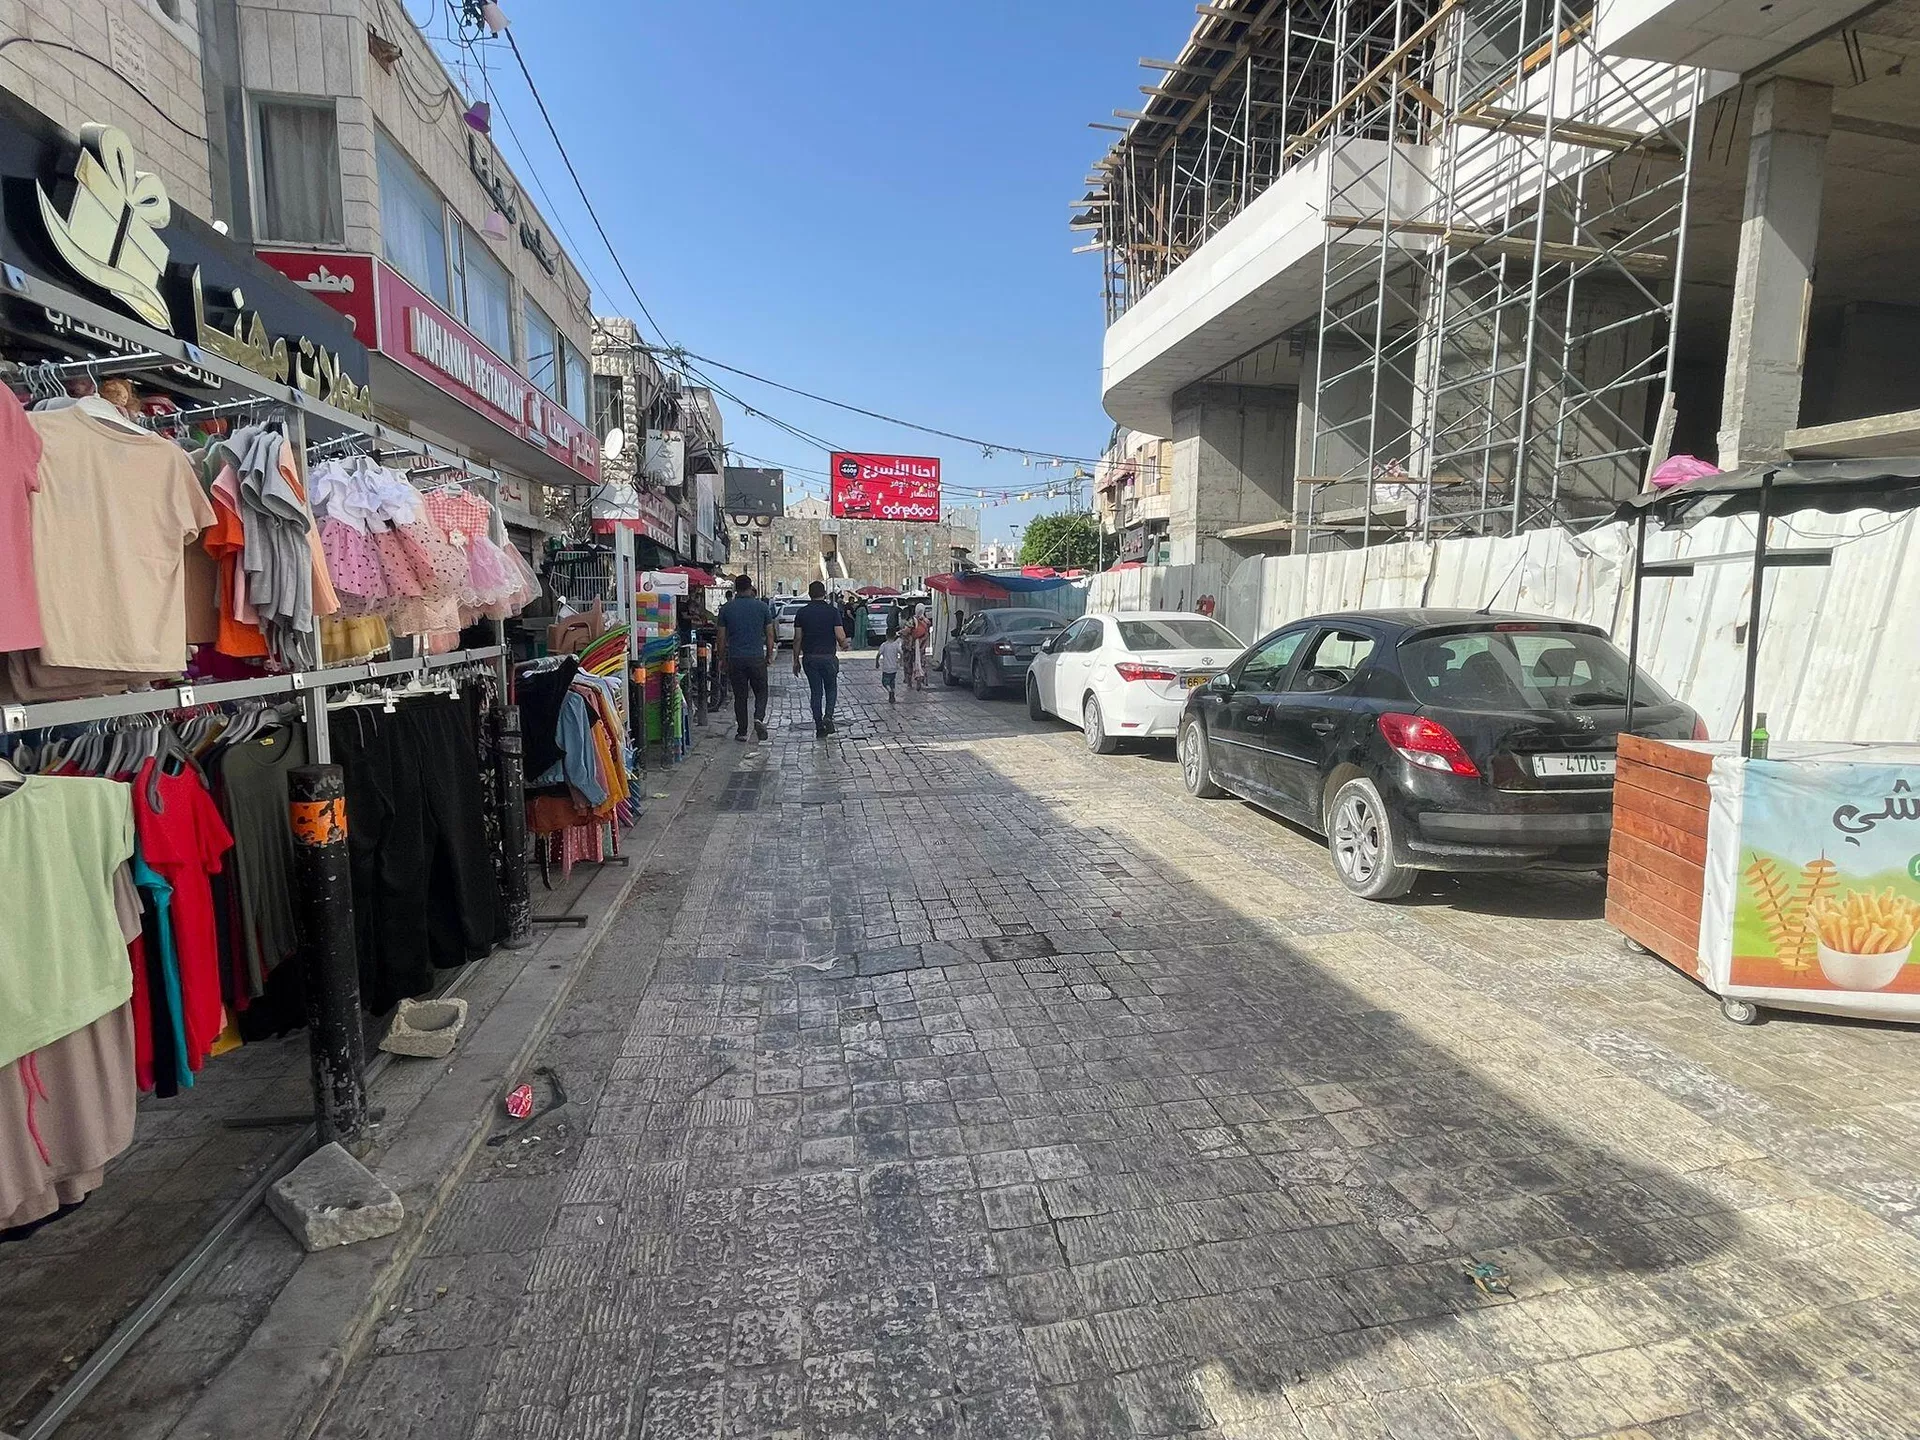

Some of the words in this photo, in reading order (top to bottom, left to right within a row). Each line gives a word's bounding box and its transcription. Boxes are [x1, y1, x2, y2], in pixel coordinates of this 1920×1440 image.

[193, 262, 289, 386] مهنا
[413, 307, 473, 391] MUHANNA
[473, 353, 524, 424] RESTAURANT
[547, 406, 570, 450] مهنا
[863, 459, 910, 479] الأسرع
[912, 464, 936, 478] احنا
